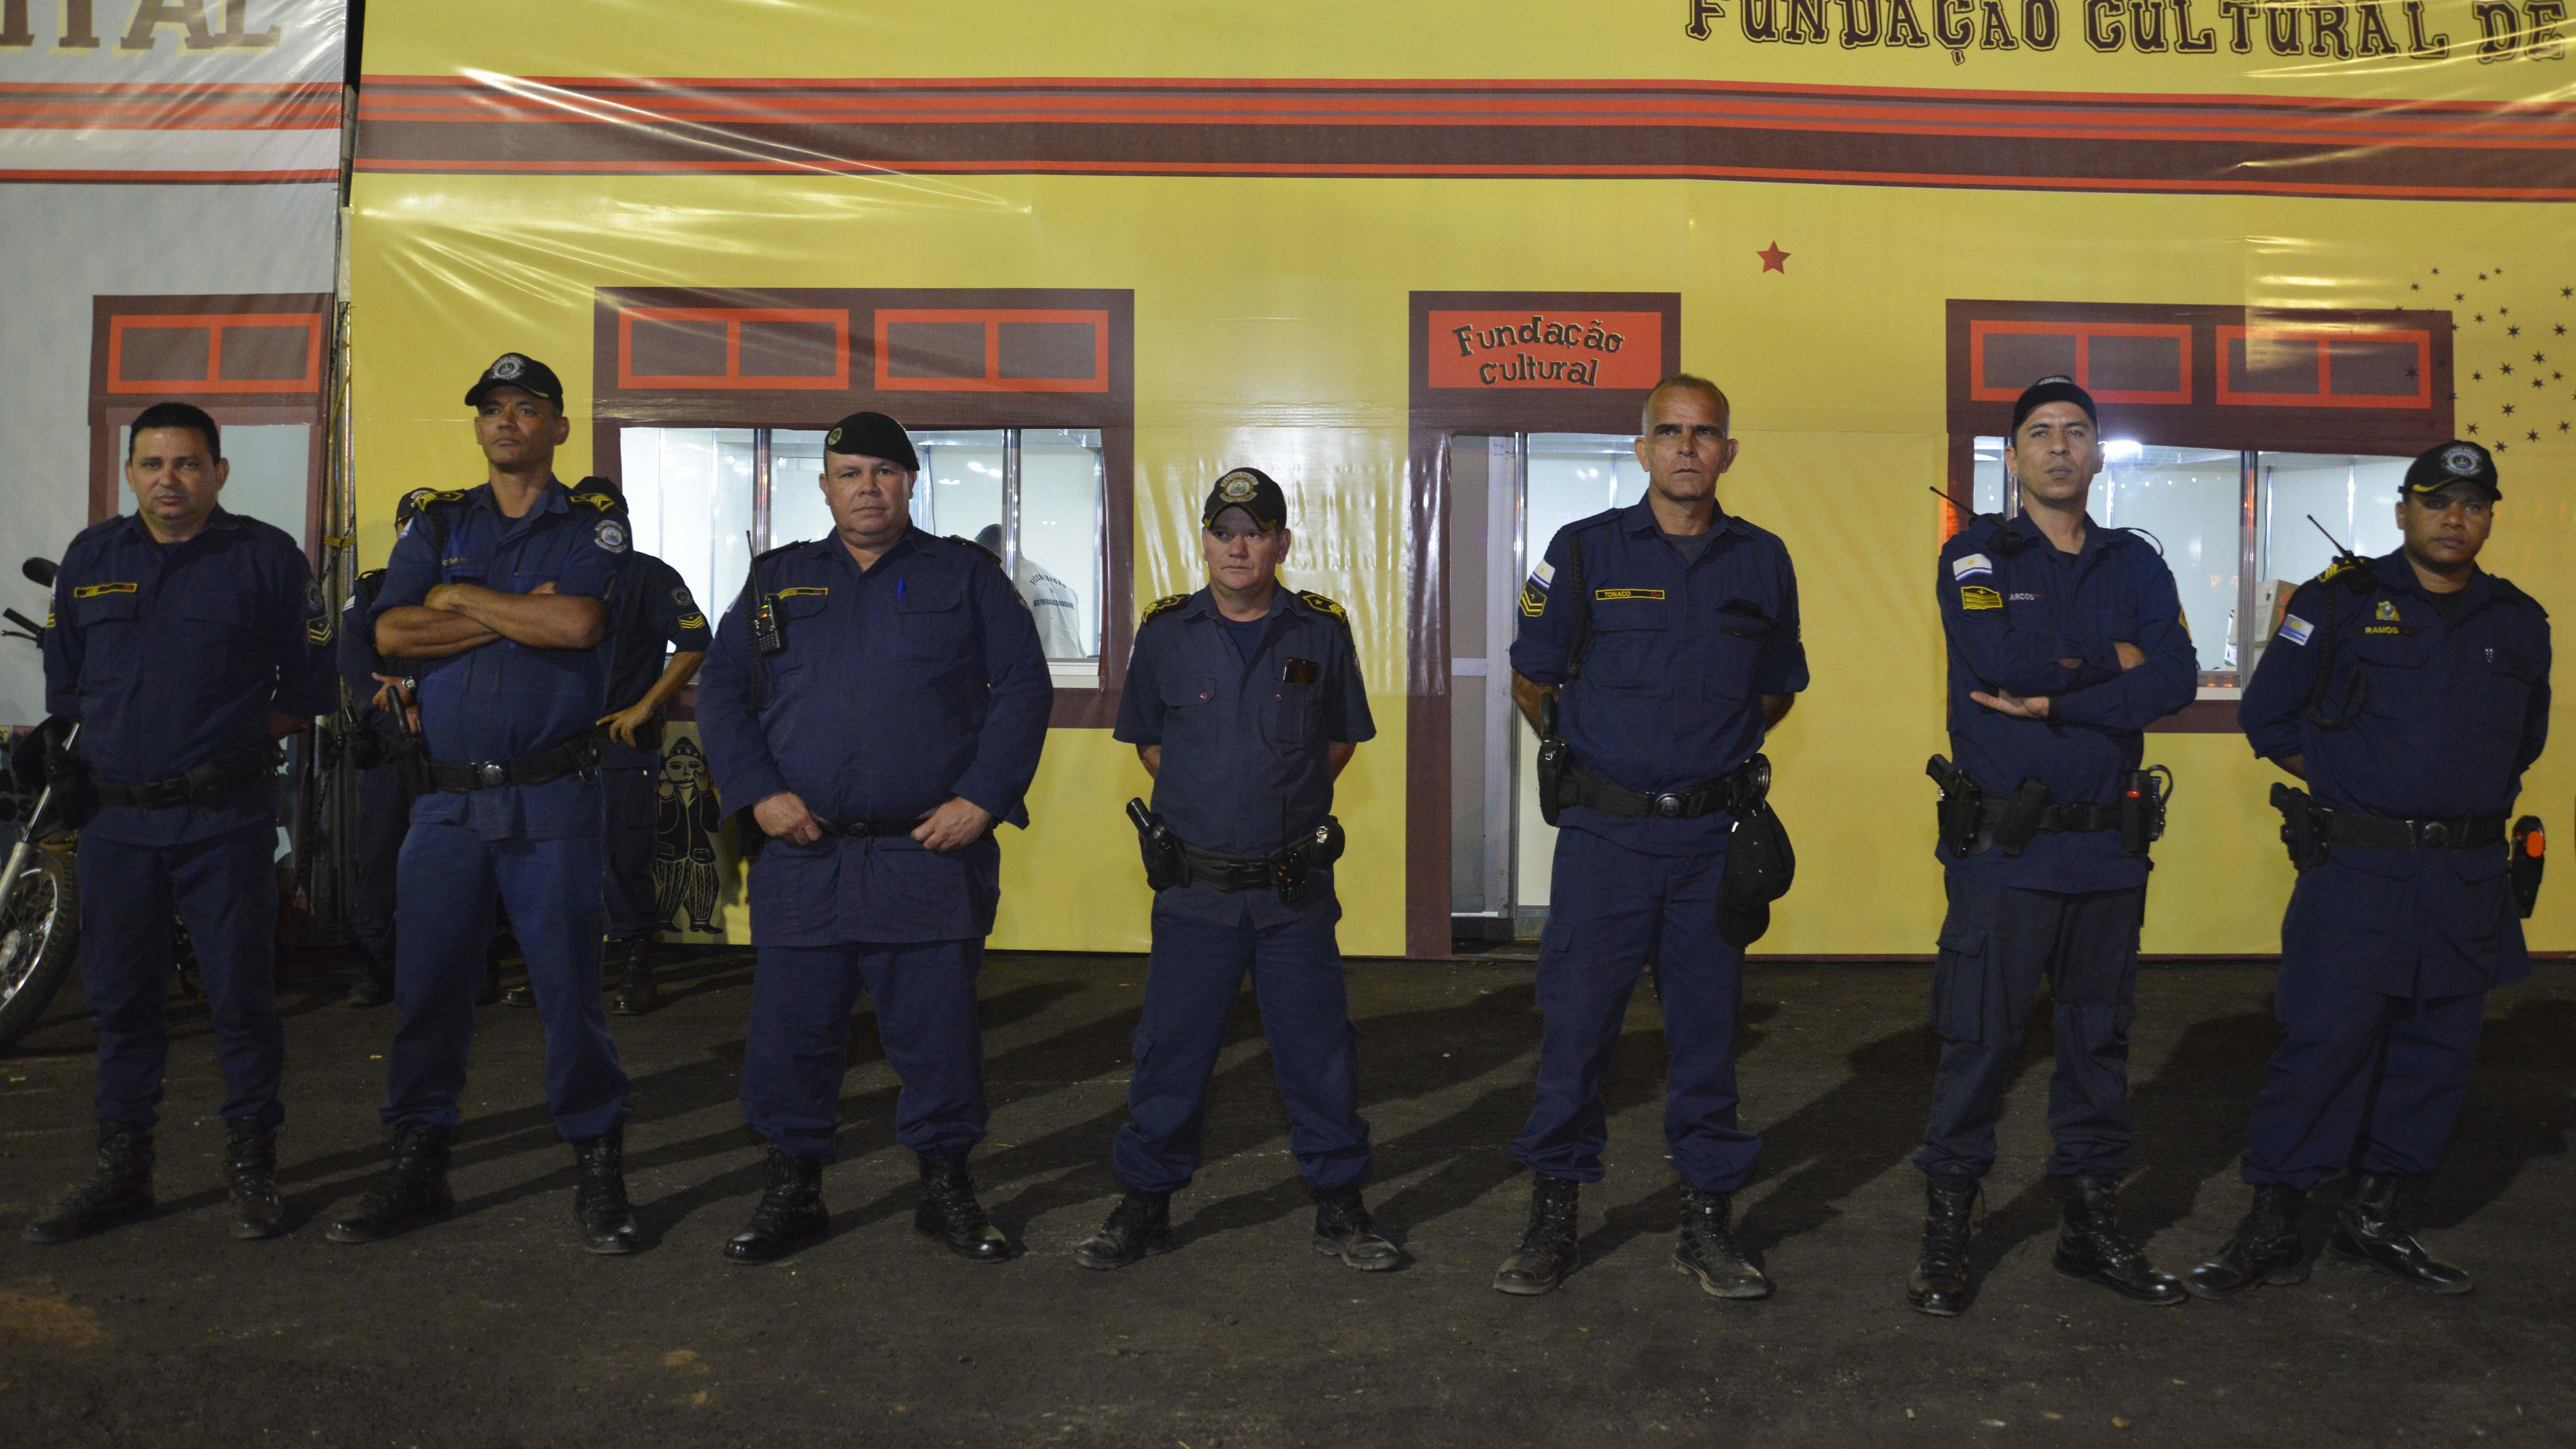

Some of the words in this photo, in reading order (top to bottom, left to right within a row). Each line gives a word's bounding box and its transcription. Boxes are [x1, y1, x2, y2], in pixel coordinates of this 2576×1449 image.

[2085, 0, 2450, 60] CULTURAL
[2472, 0, 2567, 65] DE
[1453, 315, 1625, 357] Fundação
[2364, 626, 2399, 634] RAMOS
